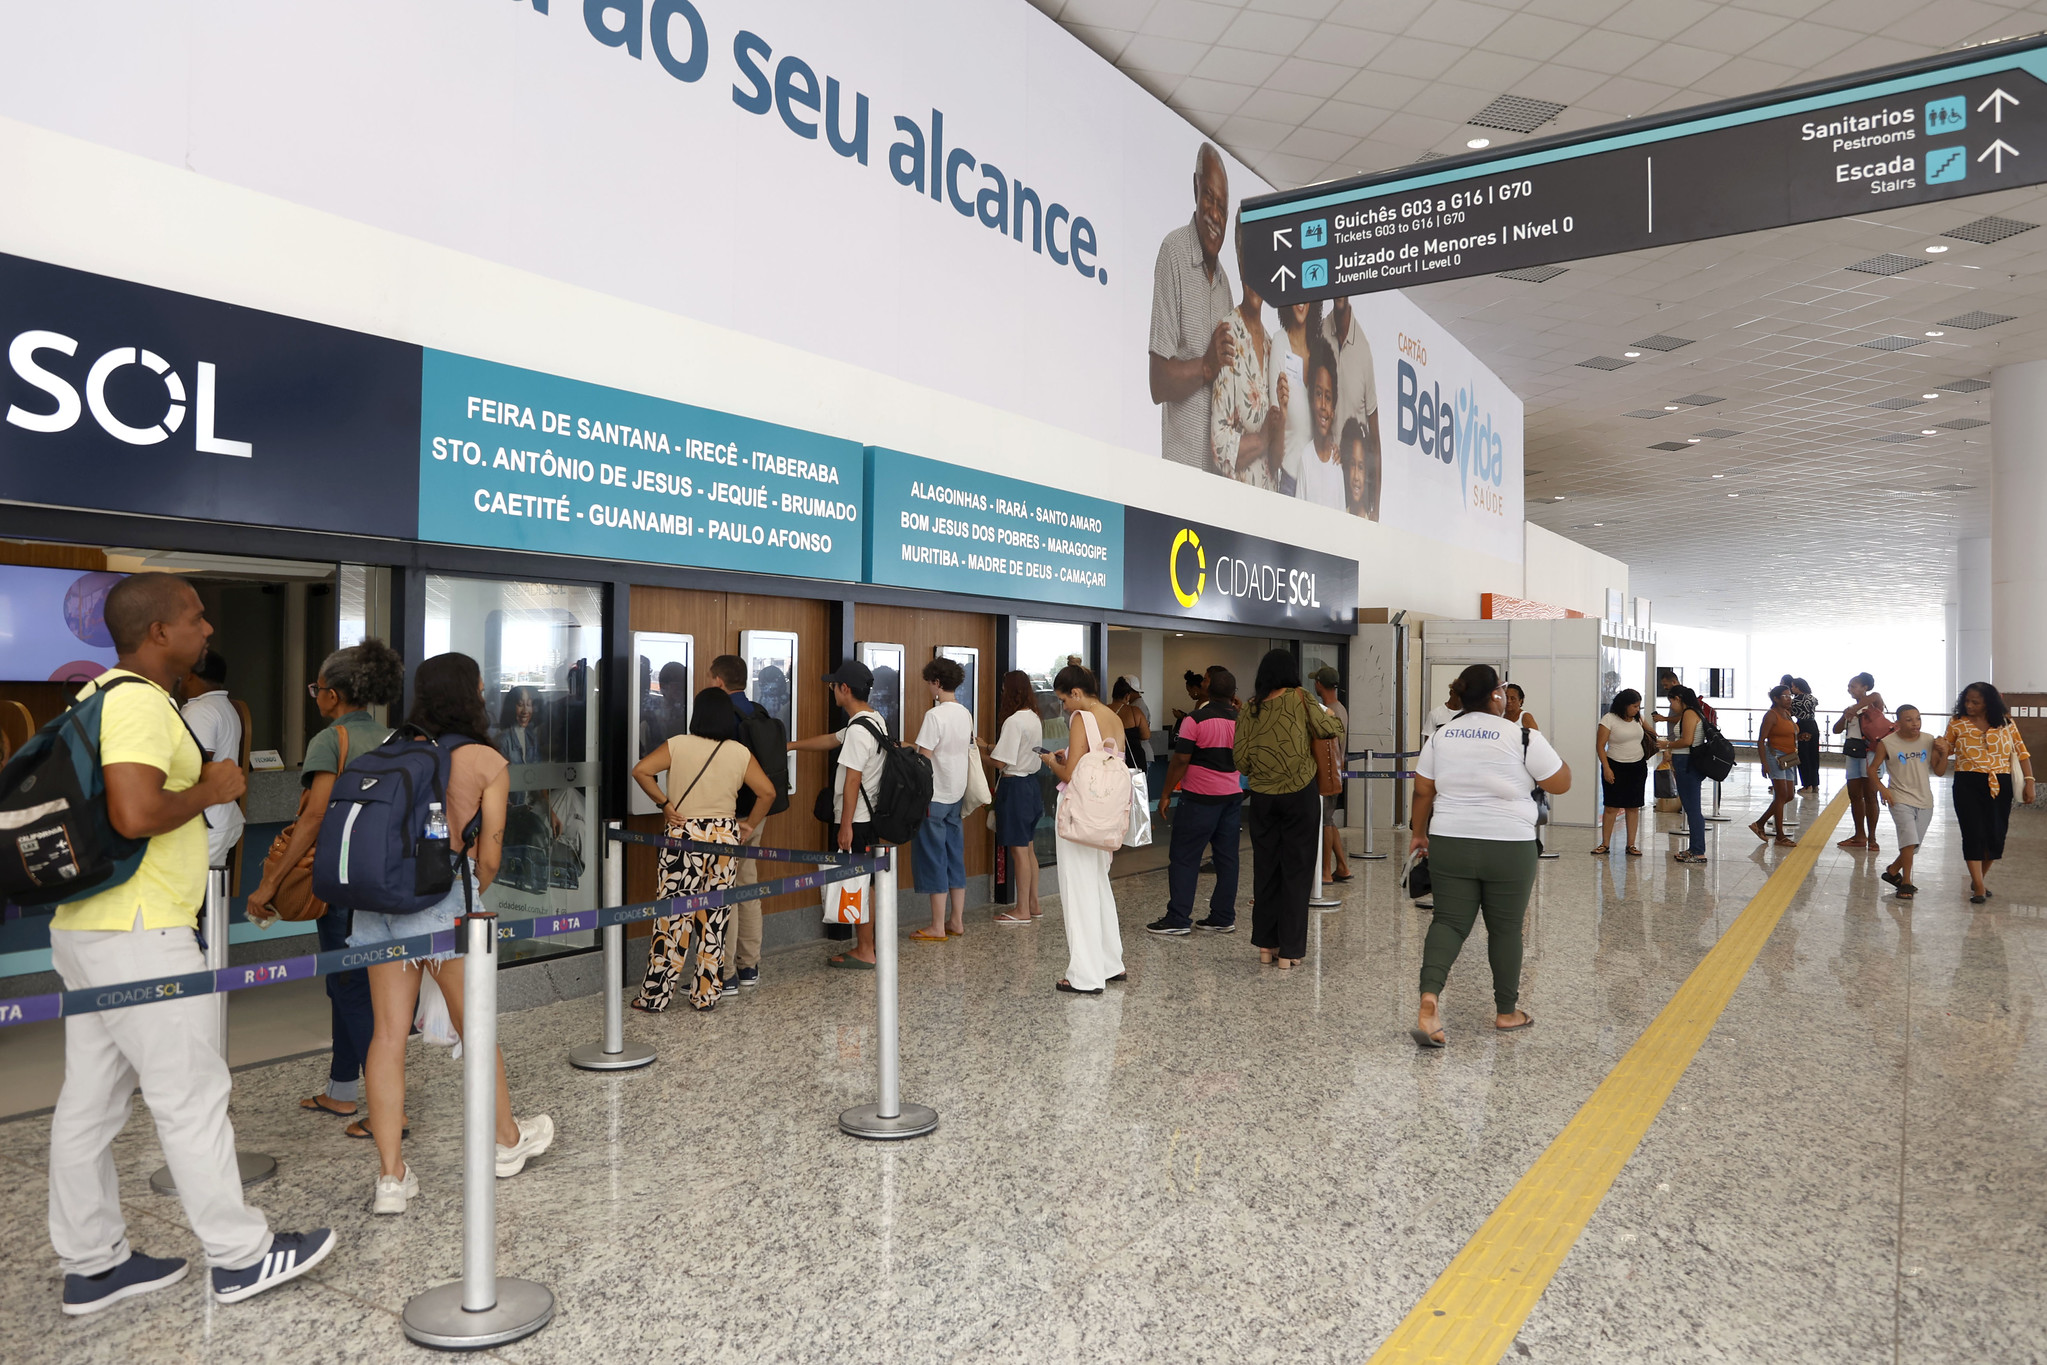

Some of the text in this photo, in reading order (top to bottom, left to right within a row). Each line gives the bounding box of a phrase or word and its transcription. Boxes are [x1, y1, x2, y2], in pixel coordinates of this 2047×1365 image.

[1802, 109, 1915, 142] Sanitarios
[732, 30, 869, 167] seu
[889, 107, 1108, 286] alcance.
[1837, 155, 1916, 184] Escada
[1335, 205, 1396, 231] Guichês
[1401, 199, 1433, 219] G03
[1436, 199, 1445, 211] a
[1451, 190, 1483, 209] G16
[1499, 181, 1532, 200] G70
[1871, 178, 1916, 194] Stairs
[1335, 230, 1372, 244] Tickets
[1375, 224, 1395, 237] G03
[1398, 222, 1409, 233] to
[1412, 217, 1433, 231] G16
[1444, 212, 1465, 225] G70
[1335, 248, 1395, 272] Juizado
[1400, 243, 1419, 259] de
[1425, 231, 1496, 256] Menores
[1513, 220, 1558, 241] Nível
[1563, 217, 1573, 232] 0
[1335, 268, 1378, 284] Juvenile
[1381, 263, 1411, 278] Court
[1422, 256, 1451, 270] Level
[1454, 254, 1460, 265] 0
[1398, 332, 1427, 366] CARTÃO
[6, 329, 253, 458] SOL
[468, 397, 536, 430] FEIRA
[542, 410, 571, 436] DE
[577, 418, 670, 454] SANTANA
[686, 438, 737, 466] IRECÊ
[752, 452, 839, 485] ITABERABA
[432, 437, 486, 467] STO.
[493, 447, 594, 482] ANTÔNIO
[600, 464, 626, 488] DE
[632, 469, 692, 497] JESUS
[708, 482, 767, 509] JEQUIÉ
[782, 493, 856, 522] BRUMADO
[1473, 484, 1503, 516] SAÚDE
[474, 489, 570, 521] CAETITÉ
[589, 504, 692, 536] GUANAMBI
[708, 519, 764, 545] PAULO
[768, 527, 832, 553] AFONSO
[911, 481, 987, 511] ALAGOINHAS
[996, 498, 1028, 519] IRARÁ
[1036, 507, 1068, 528] SANTO
[1069, 514, 1102, 533] AMARO
[901, 511, 929, 531] BOM
[932, 517, 969, 538] JESUS
[972, 524, 995, 542] DOS
[998, 528, 1039, 549] POBRES
[1048, 538, 1107, 560] MARAGOGIPE
[902, 544, 959, 568] MURITIBA
[968, 553, 1006, 573] MADRE
[1010, 559, 1023, 576] DE
[1026, 562, 1052, 580] DEUS
[1060, 567, 1107, 588] CAMAÇARI
[1445, 727, 1500, 740] ESTAGIÁRIO
[758, 849, 777, 858] ROTA
[825, 854, 837, 863] SOL
[498, 927, 515, 939] SOL
[553, 917, 580, 932] ROTA
[614, 909, 642, 922] CIDADE
[642, 906, 657, 917] SOL
[686, 896, 709, 909] ROTA
[759, 886, 771, 896] SOL
[795, 876, 814, 888] ROTA
[855, 865, 866, 874] SOL
[96, 986, 154, 1007] CIDADE
[155, 982, 184, 998] SOL
[245, 965, 287, 984] ROTA
[342, 948, 384, 967] CIDADE
[386, 945, 408, 959] SOL
